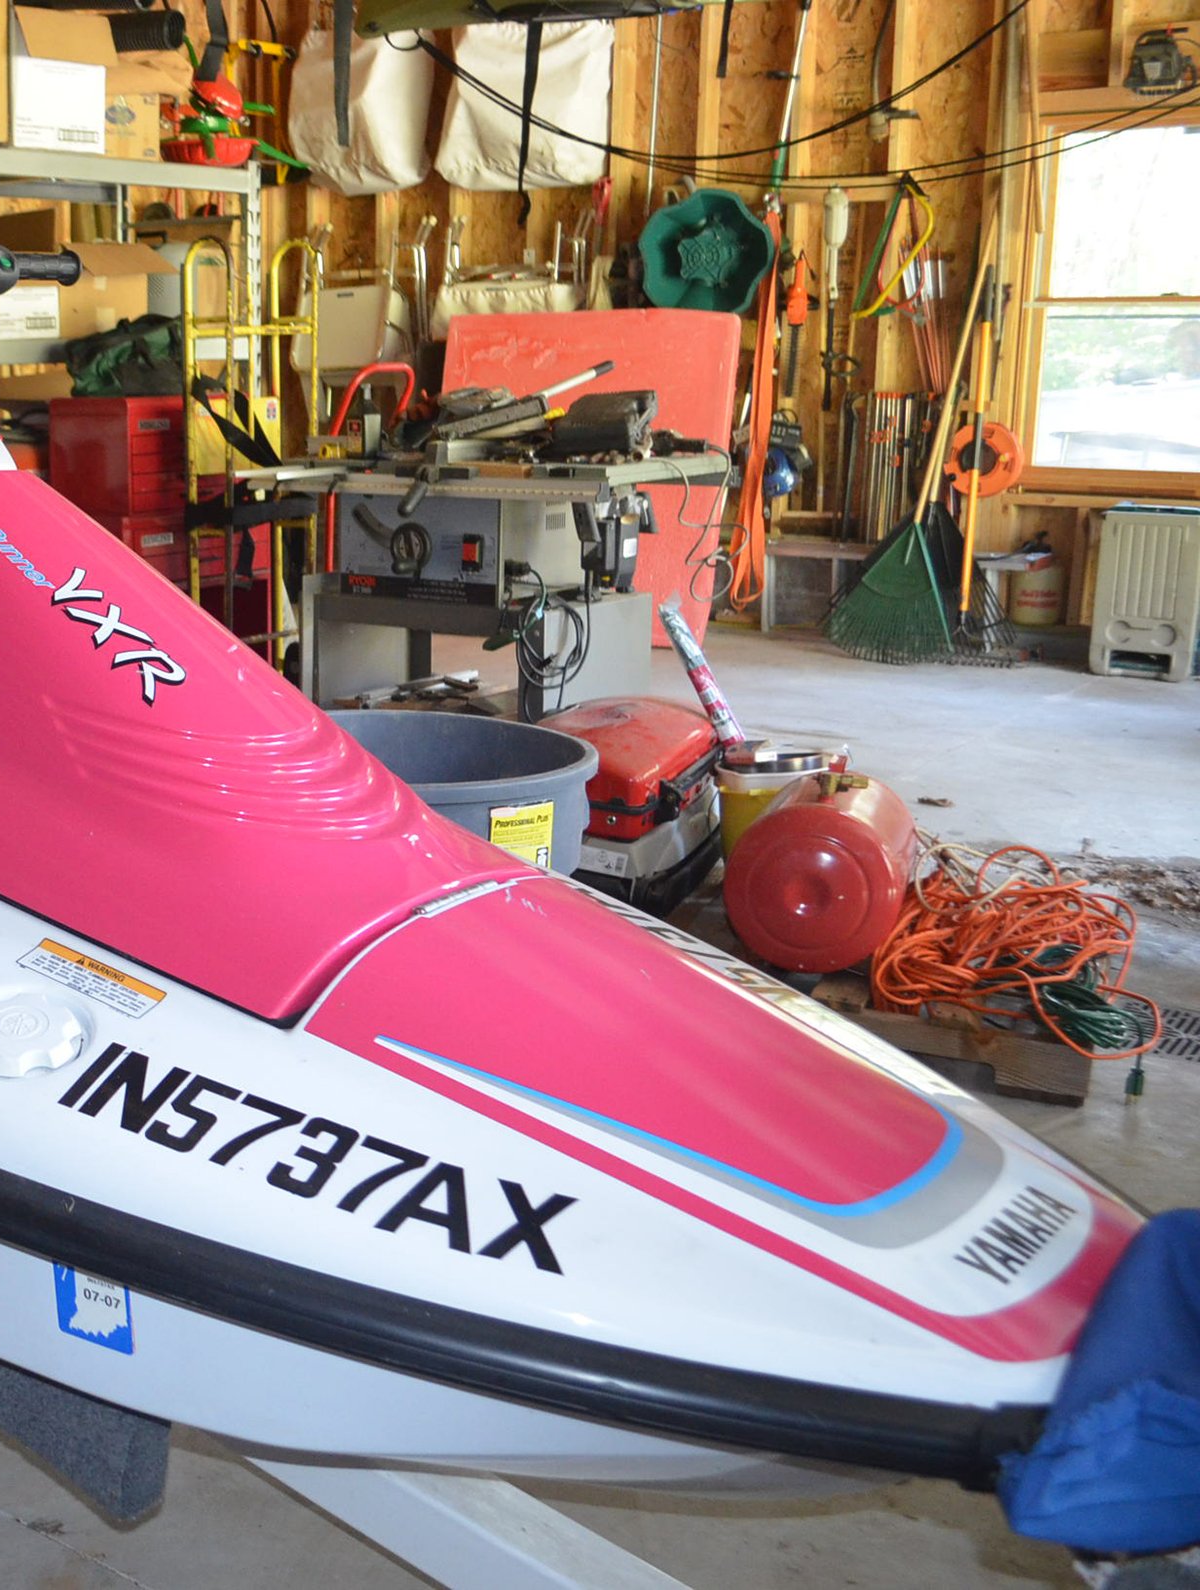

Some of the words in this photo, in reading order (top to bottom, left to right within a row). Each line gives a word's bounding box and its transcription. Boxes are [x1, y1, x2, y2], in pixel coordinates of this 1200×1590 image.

[51, 566, 187, 707] VXR
[87, 961, 126, 983] WARNING
[953, 1185, 1077, 1285] YAMAHA
[83, 1287, 121, 1309] 07-07
